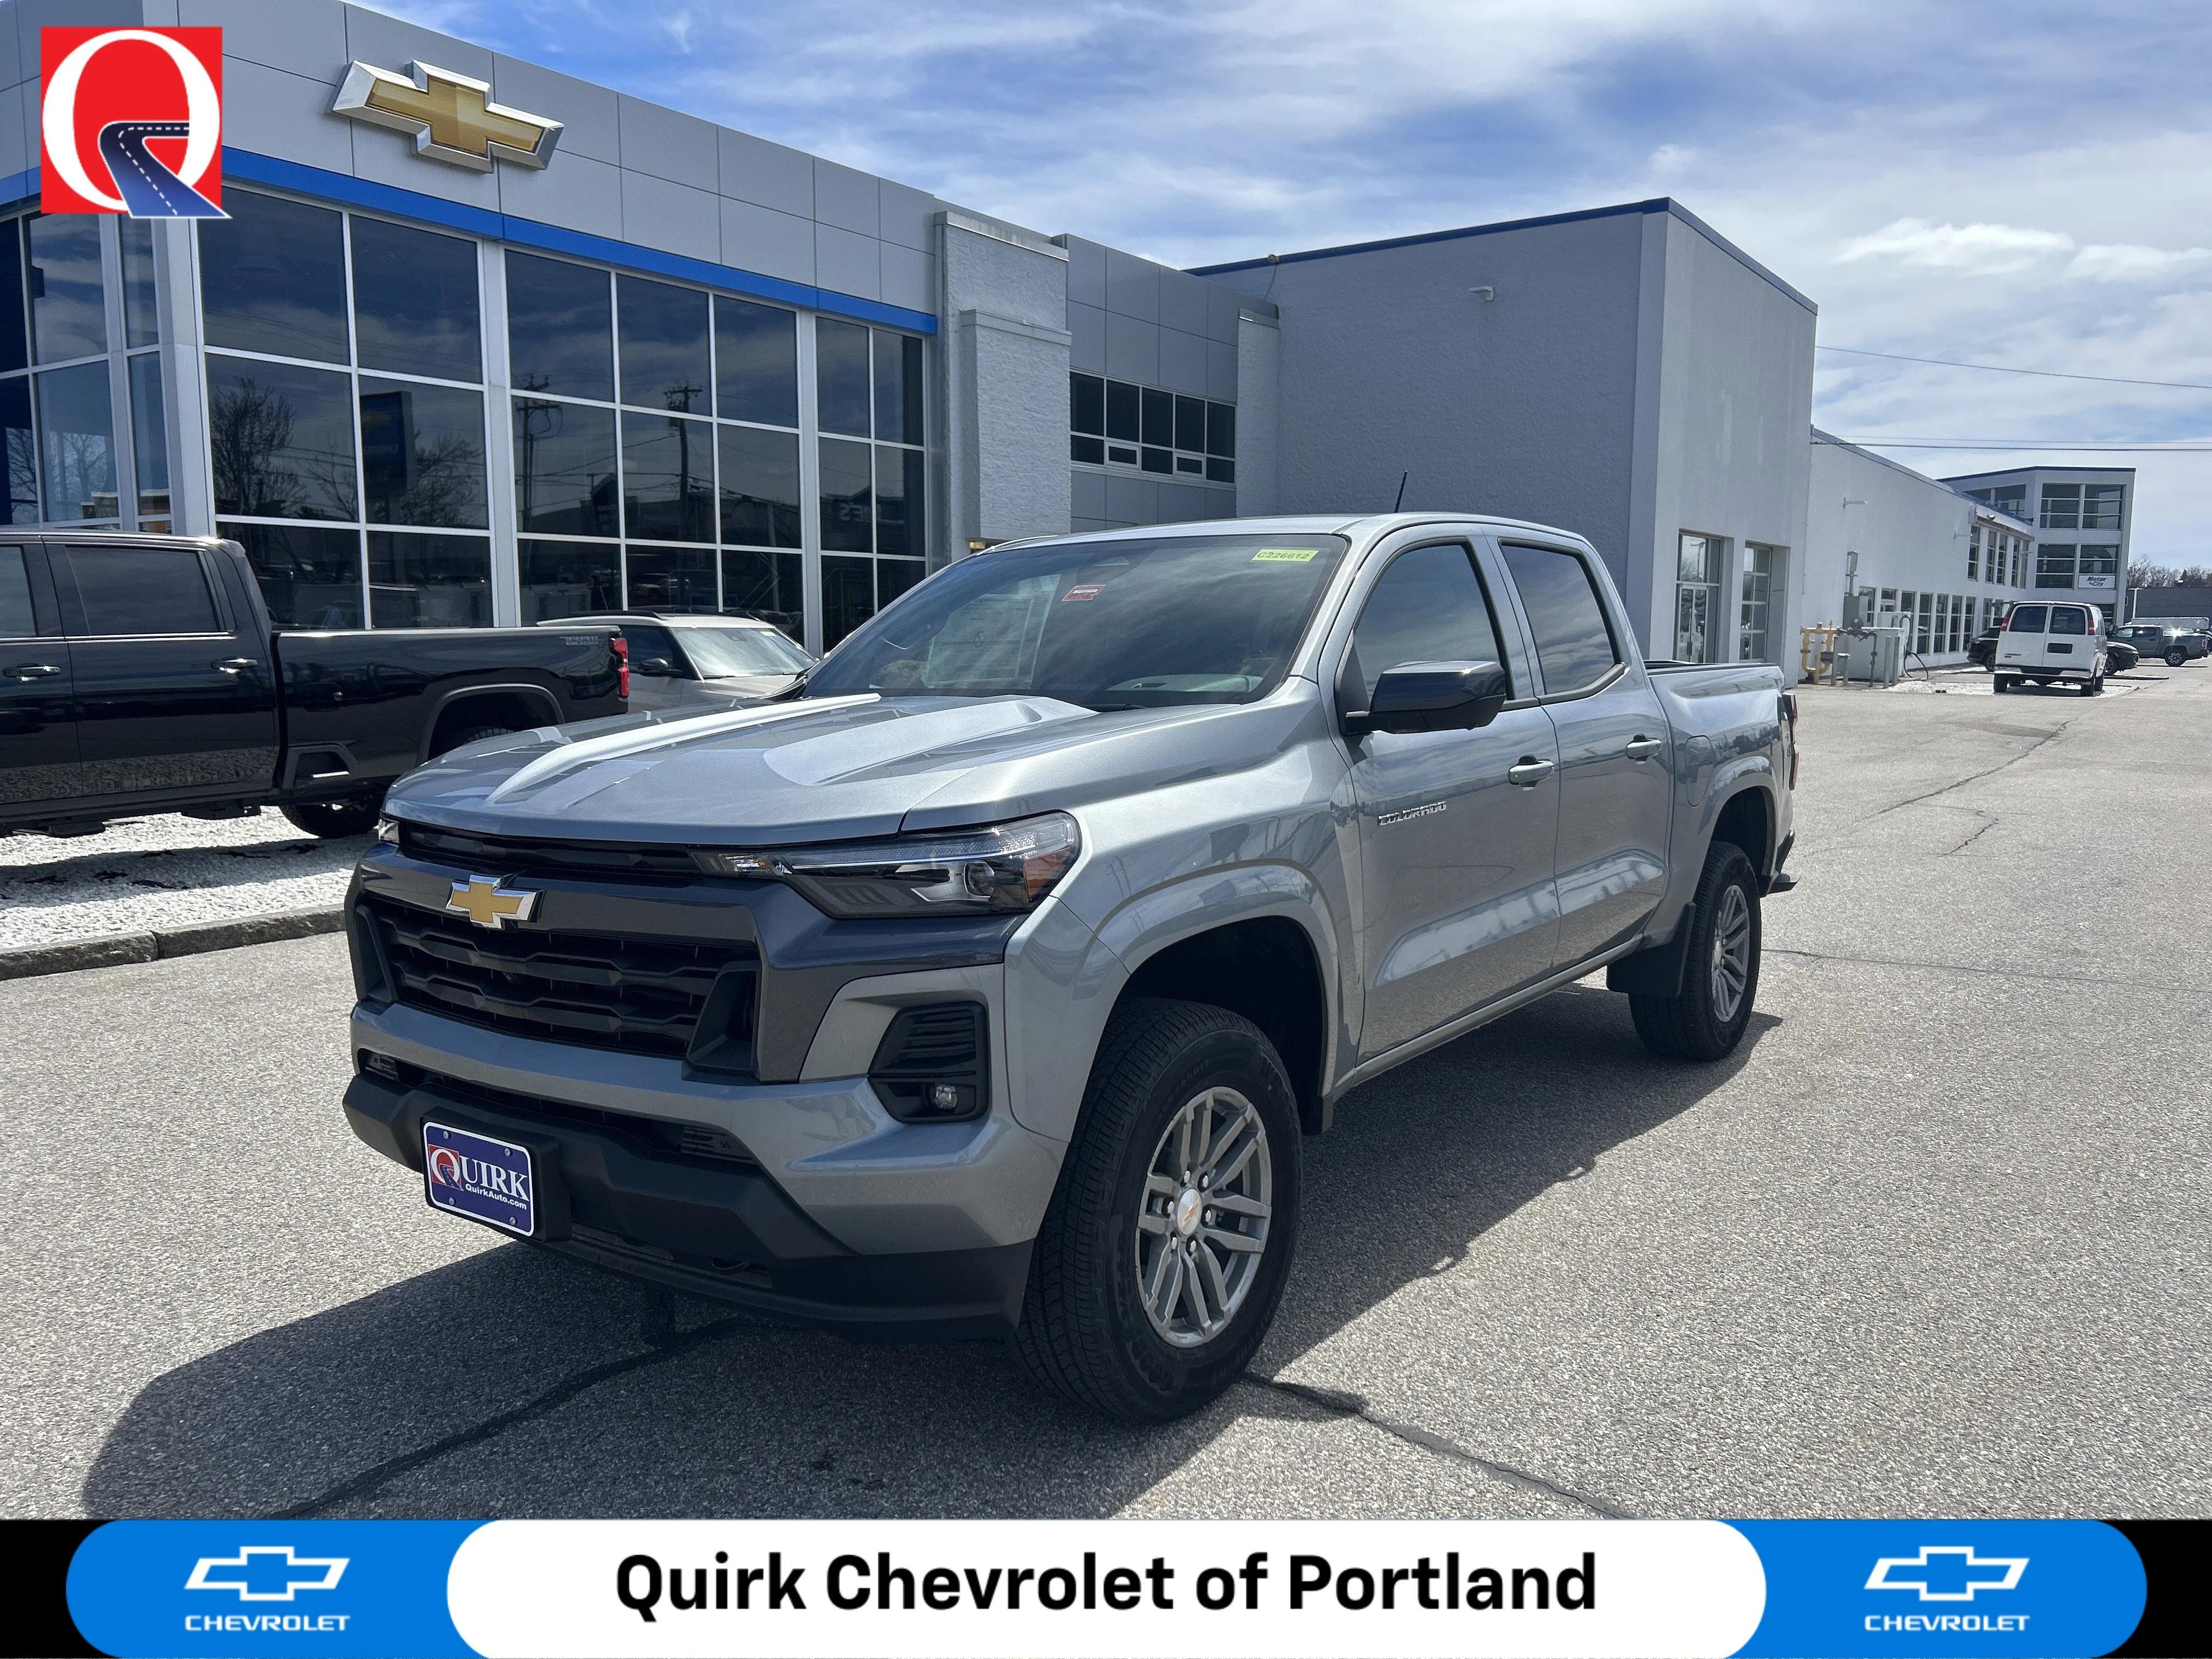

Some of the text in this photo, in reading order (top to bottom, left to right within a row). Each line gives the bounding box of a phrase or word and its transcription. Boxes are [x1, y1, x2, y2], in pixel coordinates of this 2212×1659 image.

[1378, 801, 1447, 826] COLORADO
[430, 1148, 529, 1201] QUIRK
[465, 1183, 527, 1210] QuirkAuto.com
